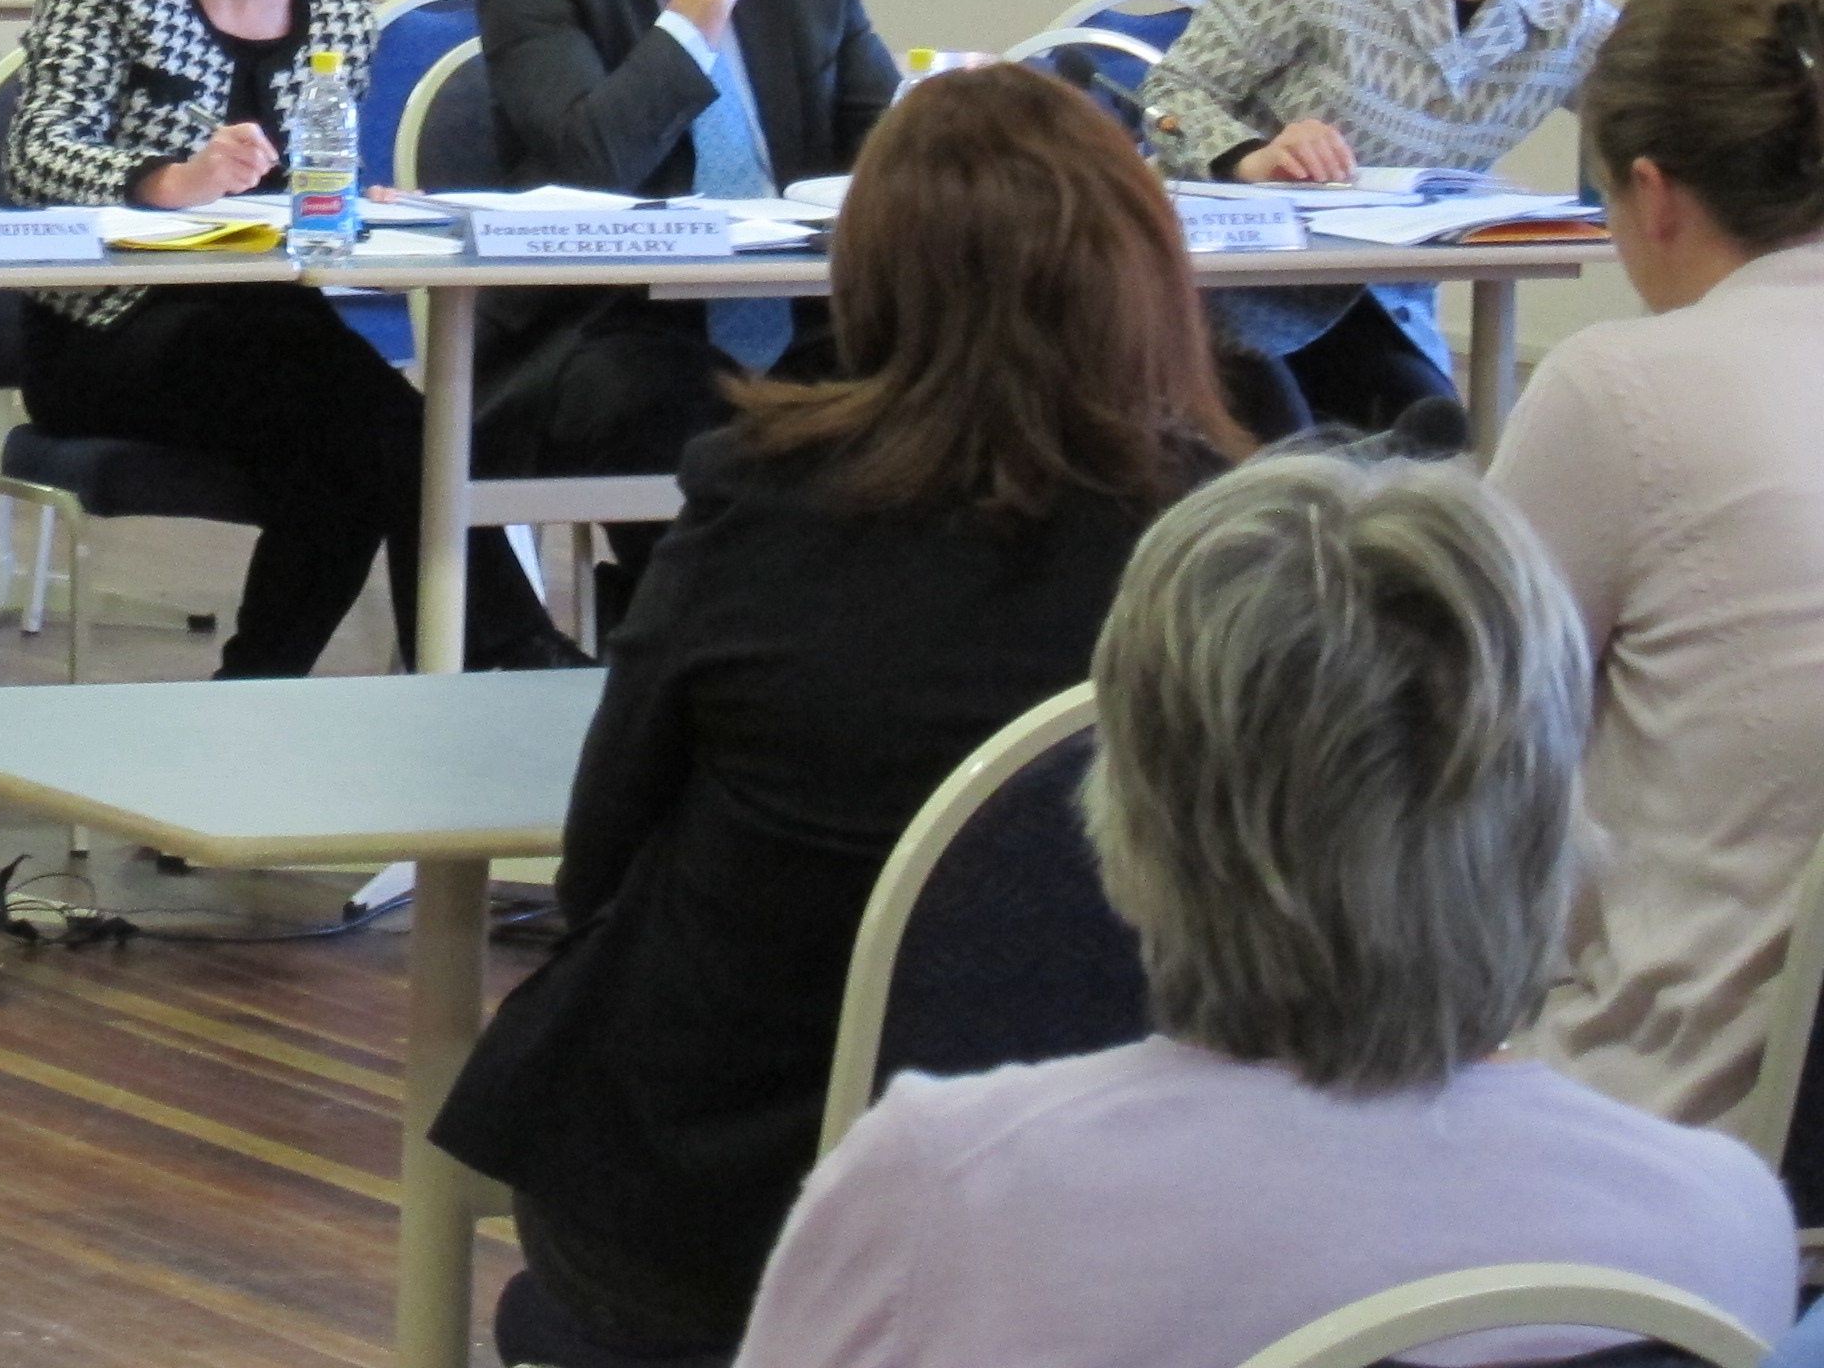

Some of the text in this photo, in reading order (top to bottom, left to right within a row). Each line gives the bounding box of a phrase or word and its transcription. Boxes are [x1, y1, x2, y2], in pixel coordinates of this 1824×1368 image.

[480, 221, 720, 237] Jeanette RADCLIFFE
[525, 239, 678, 254] SECRETARY
